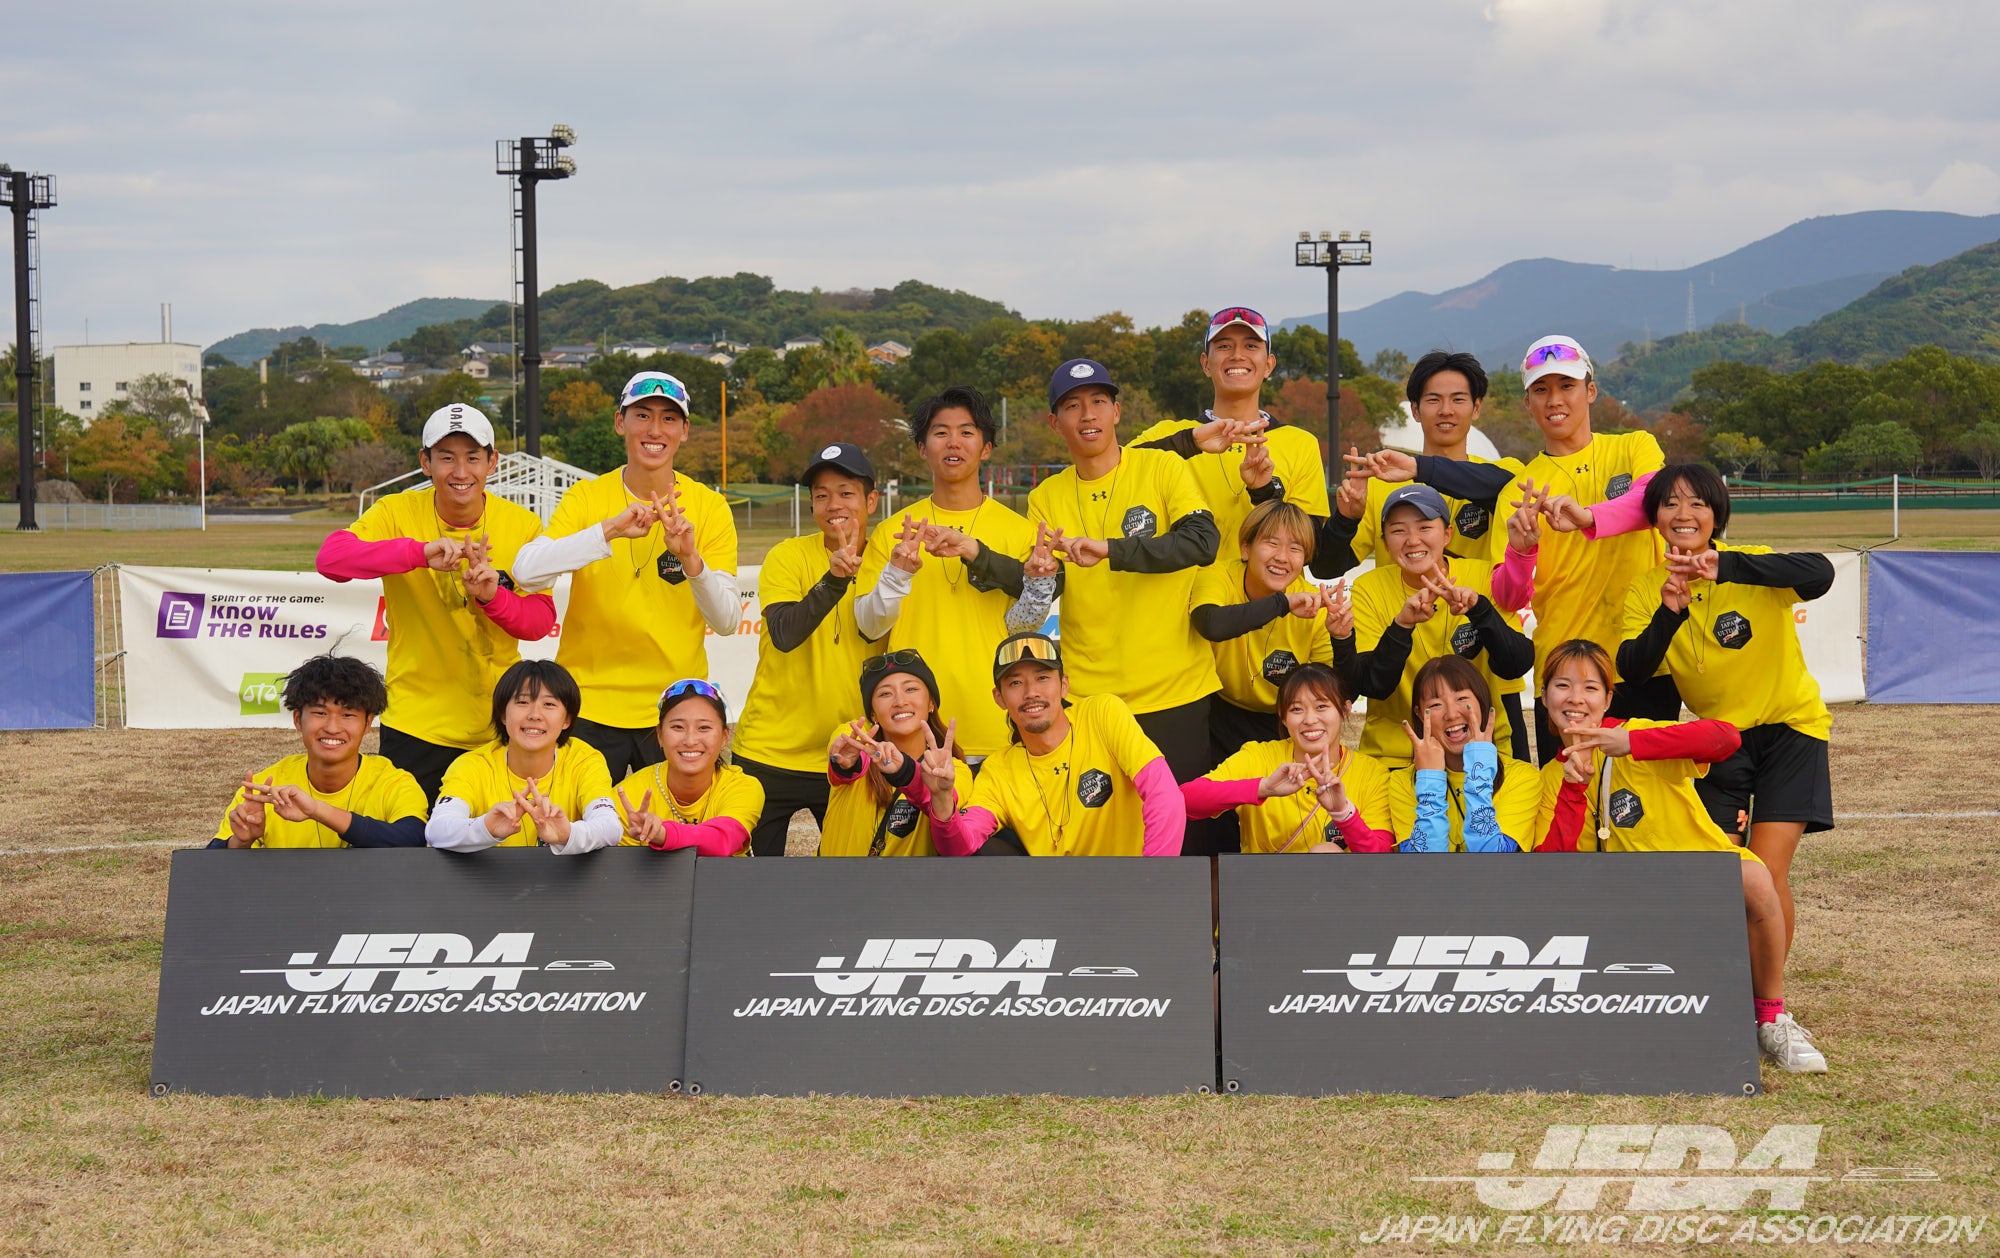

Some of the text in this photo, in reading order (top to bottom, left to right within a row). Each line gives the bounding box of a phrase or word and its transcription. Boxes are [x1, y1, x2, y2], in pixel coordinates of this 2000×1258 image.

[285, 933, 534, 991] JFDA
[814, 939, 1057, 995] JFDA
[1347, 936, 1589, 992] JFDA
[201, 992, 646, 1015] JAPAN FLYING DISC ASSOCIATION
[734, 997, 1171, 1017] JAPAN FLYING DISC ASSOCIATION
[1269, 994, 1709, 1014] JAPAN FLYING DISC ASSOCIATION
